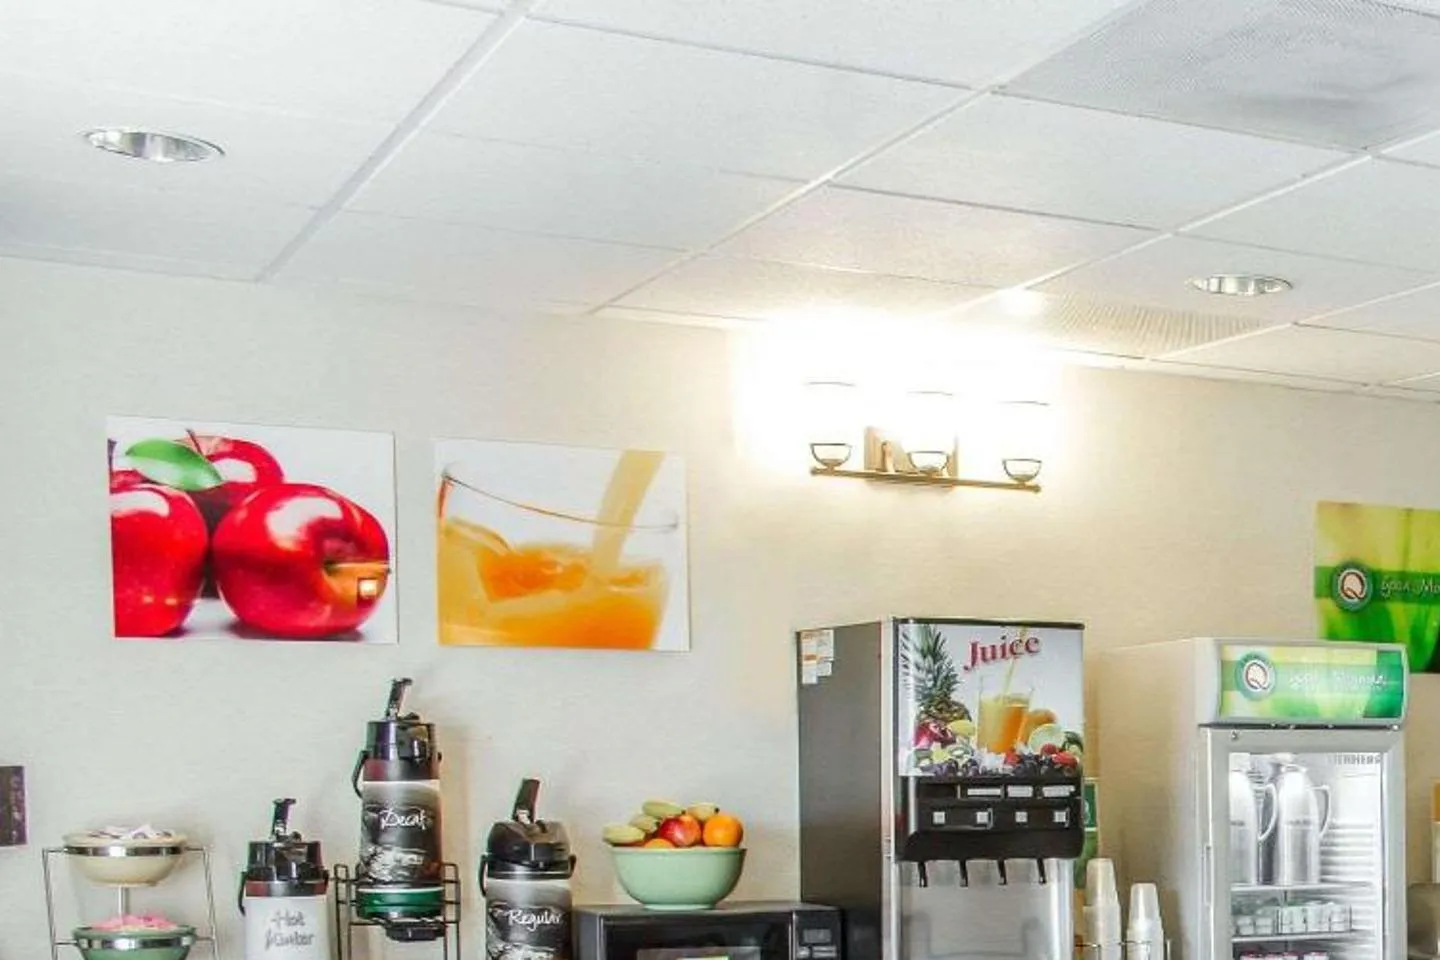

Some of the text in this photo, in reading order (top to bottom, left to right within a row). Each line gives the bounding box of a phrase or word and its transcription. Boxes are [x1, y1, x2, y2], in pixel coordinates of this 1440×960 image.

[963, 634, 1042, 671] Juice
[380, 808, 426, 830] Decaf
[271, 909, 305, 927] Hot
[504, 910, 562, 932] Regular
